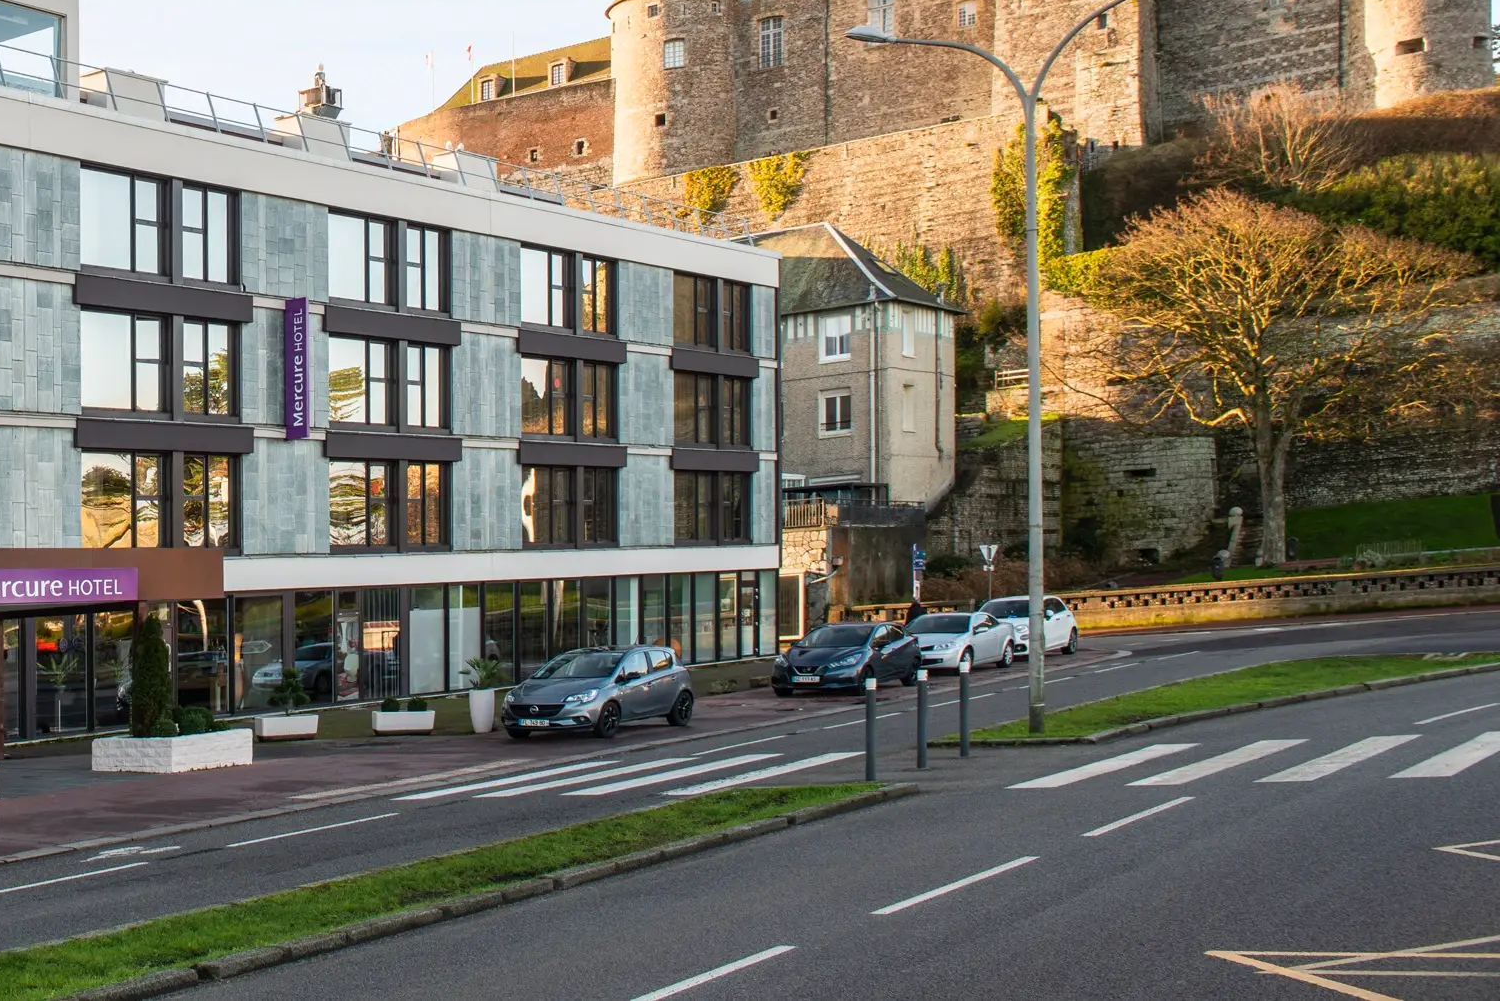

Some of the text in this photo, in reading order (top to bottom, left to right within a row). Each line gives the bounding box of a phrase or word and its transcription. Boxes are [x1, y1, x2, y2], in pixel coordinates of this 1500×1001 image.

[292, 308, 304, 428] Mercure HOTEL
[68, 578, 123, 596] HOTEL
